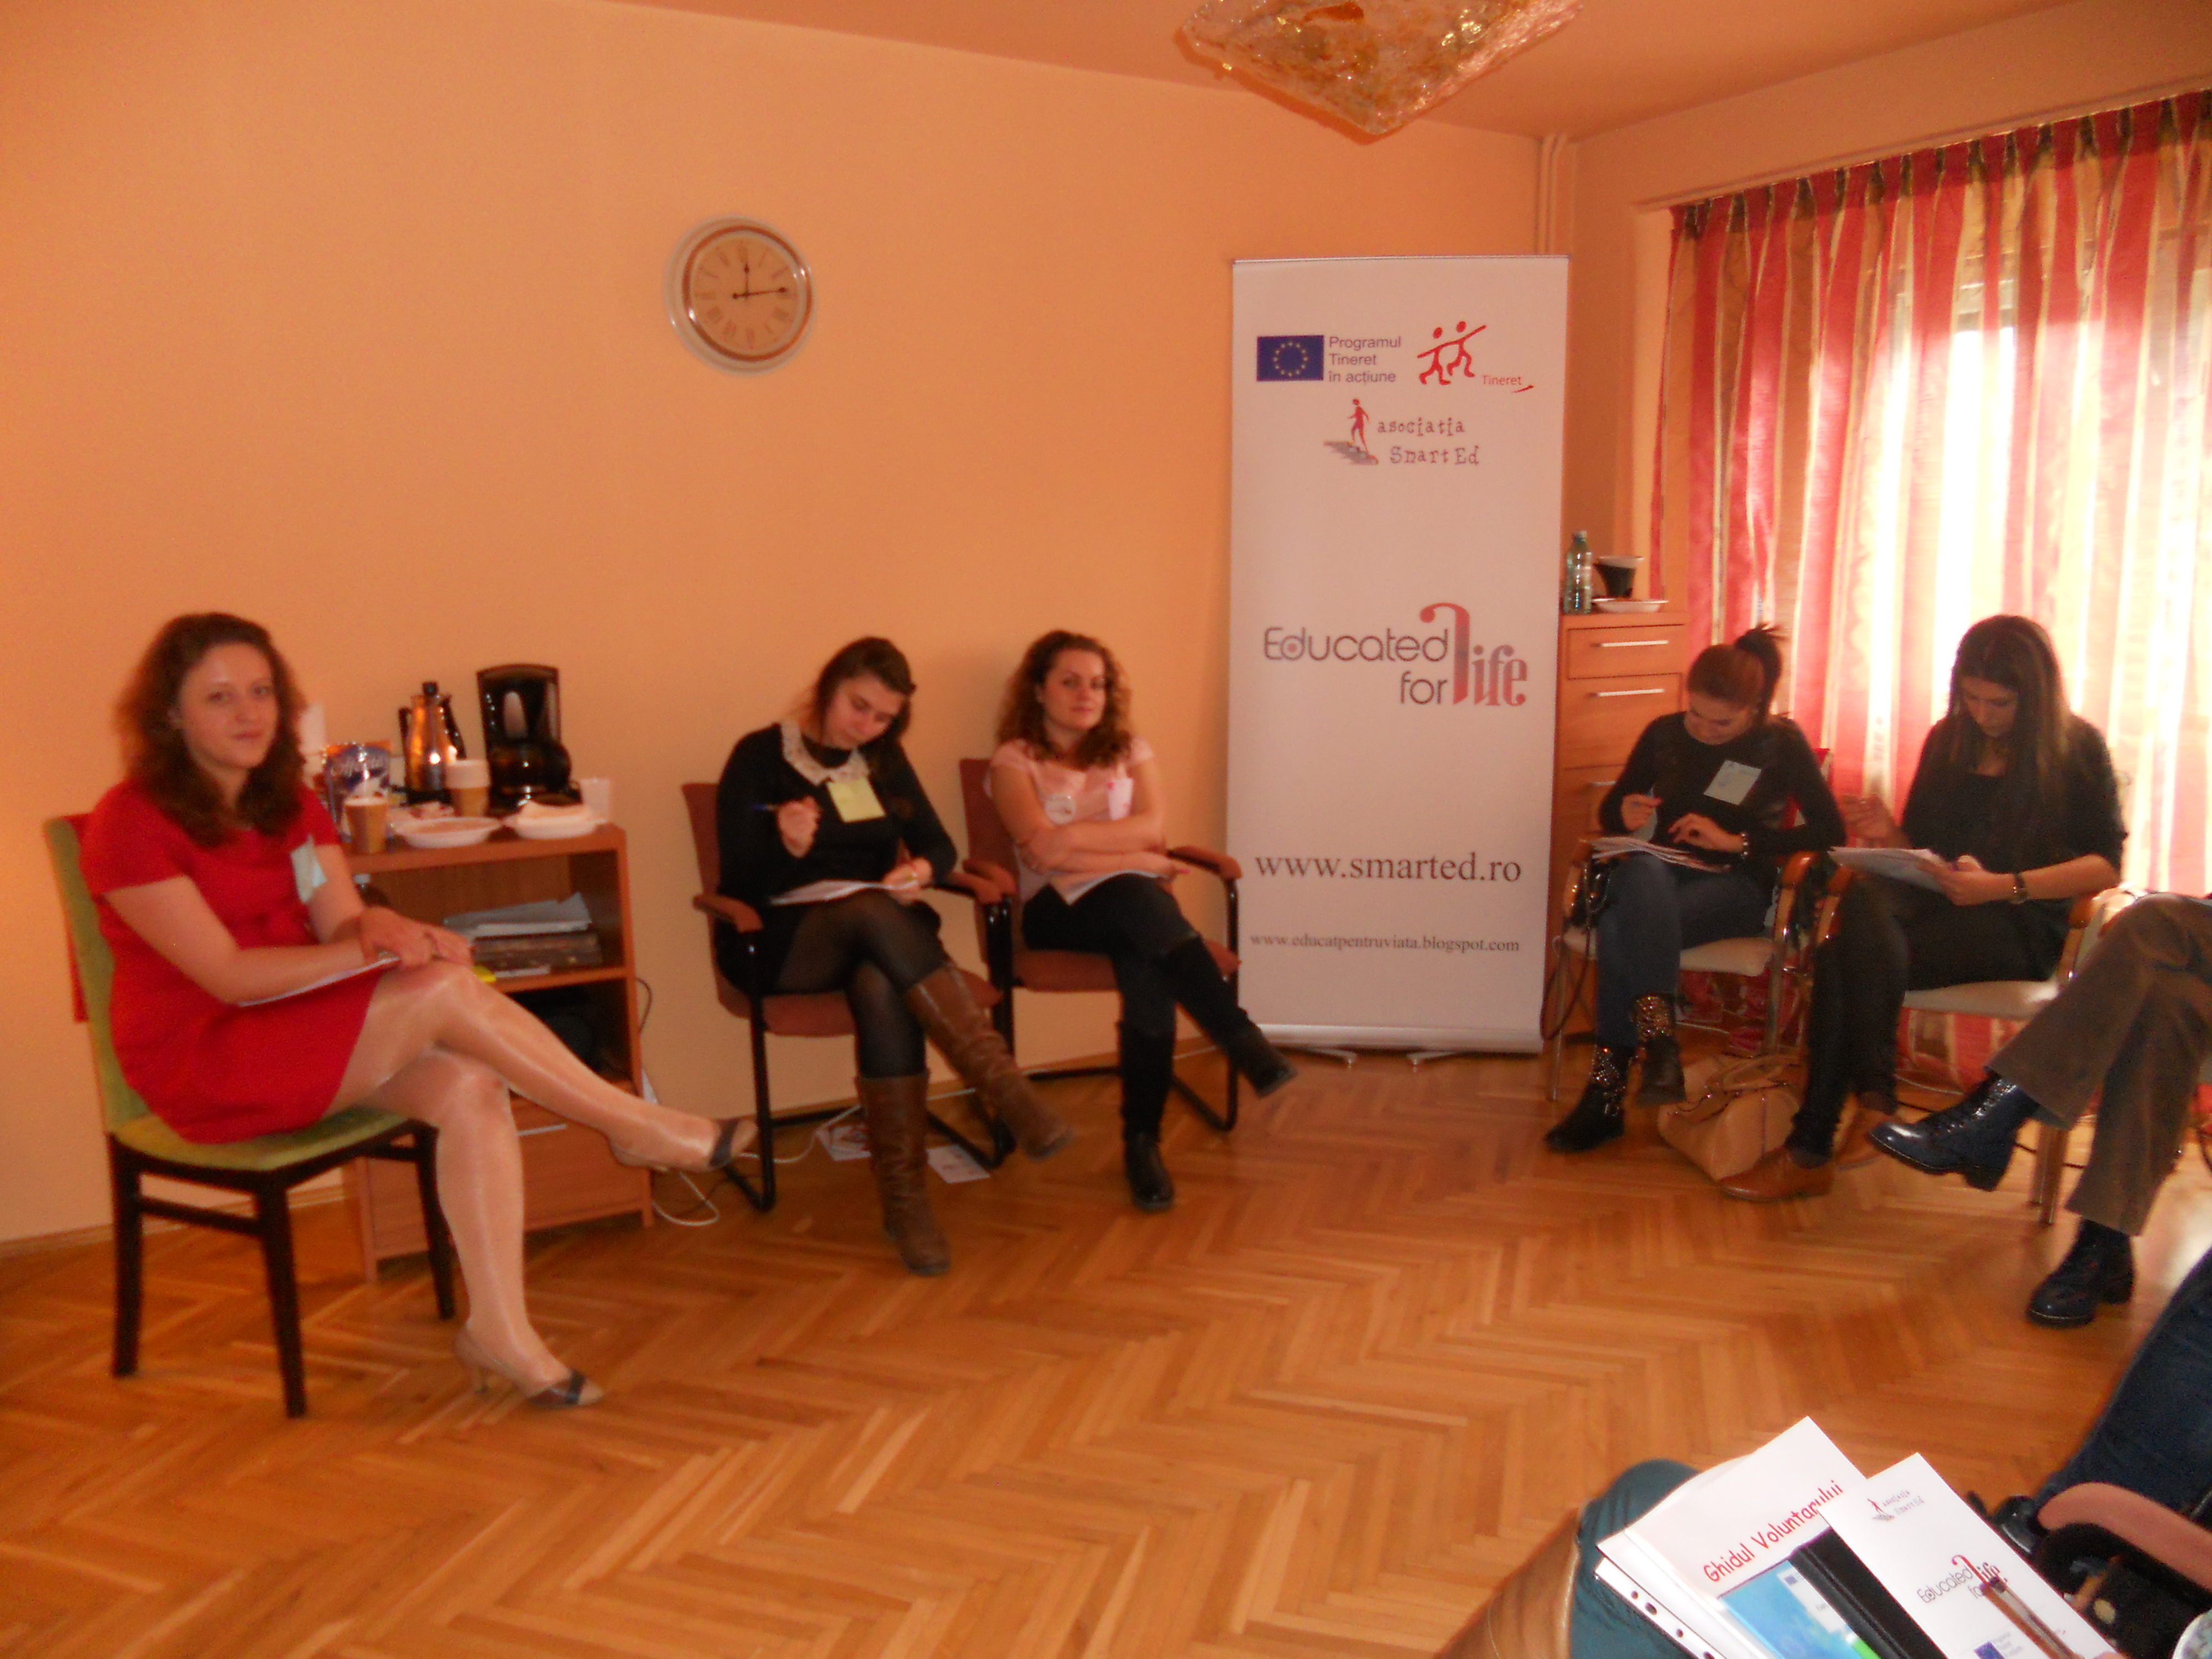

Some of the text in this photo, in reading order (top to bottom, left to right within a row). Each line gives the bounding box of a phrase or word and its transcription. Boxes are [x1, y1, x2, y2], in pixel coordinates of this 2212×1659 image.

[1328, 353, 1376, 366] Tineret
[1329, 336, 1401, 351] Programul
[1481, 375, 1522, 385] Tineret
[1264, 626, 1449, 662] Educated
[1400, 670, 1448, 705] for
[1254, 851, 1522, 883] www.smarted.ro
[1703, 1542, 1755, 1583] Ghidul
[1916, 1564, 1974, 1603] Educated
